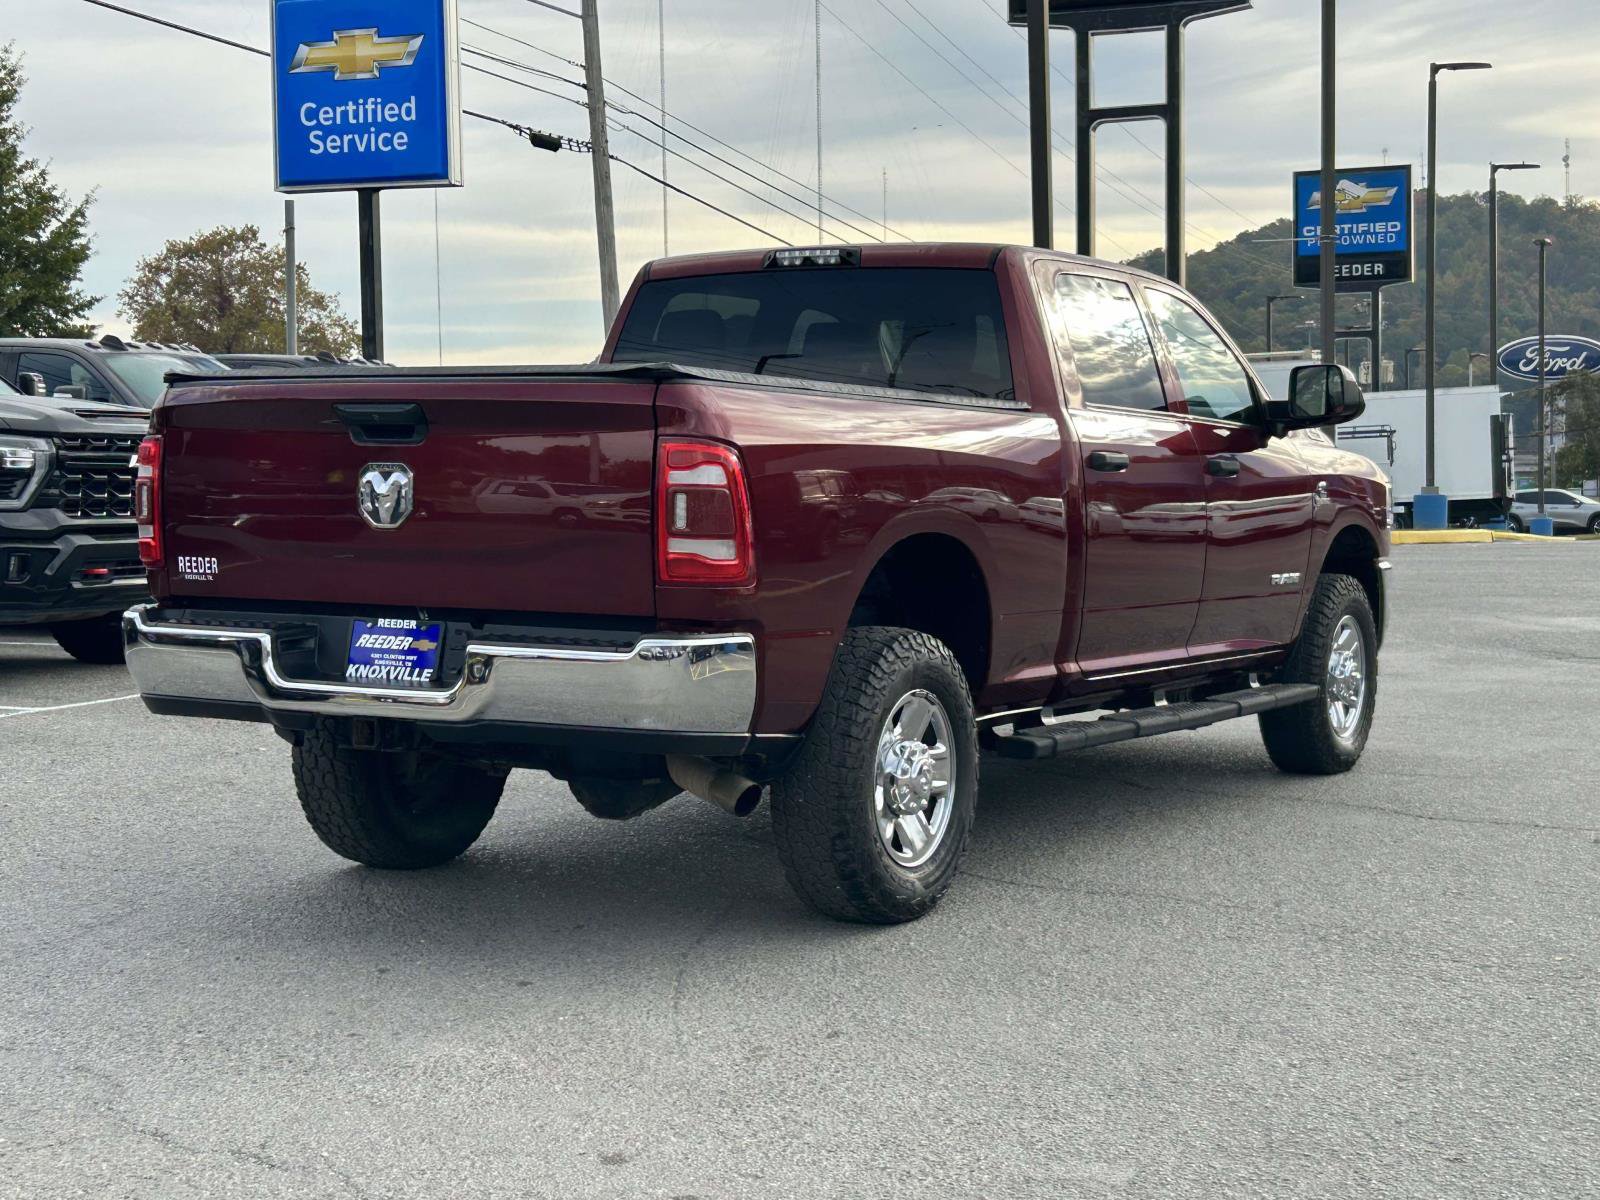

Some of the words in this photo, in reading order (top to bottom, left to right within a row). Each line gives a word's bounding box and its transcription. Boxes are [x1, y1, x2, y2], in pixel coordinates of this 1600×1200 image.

[300, 95, 416, 126] Certified
[309, 127, 409, 155] Service
[1519, 345, 1588, 372] Ford
[178, 556, 219, 574] REEDER
[377, 618, 417, 629] REEDER
[355, 633, 414, 650] REEDER
[345, 664, 434, 682] KNOXVILLE
